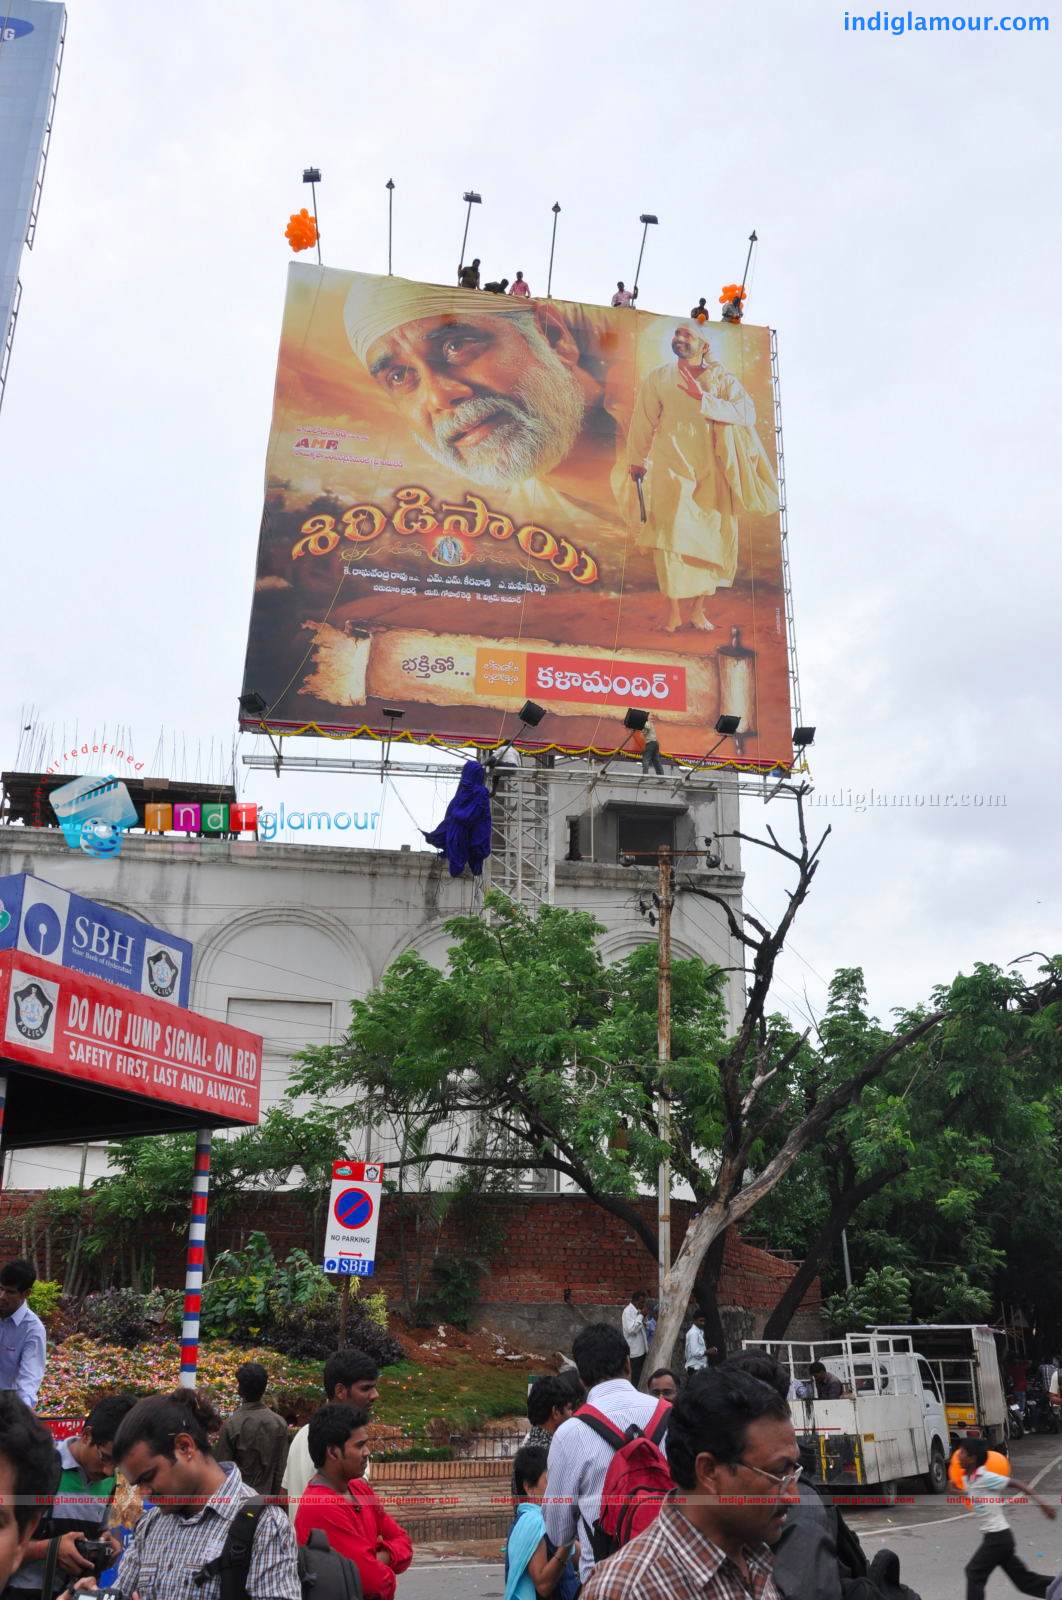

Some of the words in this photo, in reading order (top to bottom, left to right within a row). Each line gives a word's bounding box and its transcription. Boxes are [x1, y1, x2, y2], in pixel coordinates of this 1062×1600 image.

[536, 666, 670, 699] కళామందిర్
[72, 916, 136, 967] SBH
[68, 994, 89, 1032] DO
[92, 1002, 122, 1041] NOT
[124, 1012, 161, 1051] JUMP
[215, 1042, 233, 1074] ON
[236, 1049, 257, 1081] RED
[69, 1040, 112, 1070] SAFETY
[116, 1054, 149, 1084] FIRST,
[153, 1064, 178, 1088] LAST
[180, 1072, 204, 1094] AND
[341, 1235, 371, 1244] PARKING
[340, 1259, 369, 1273] SBH
